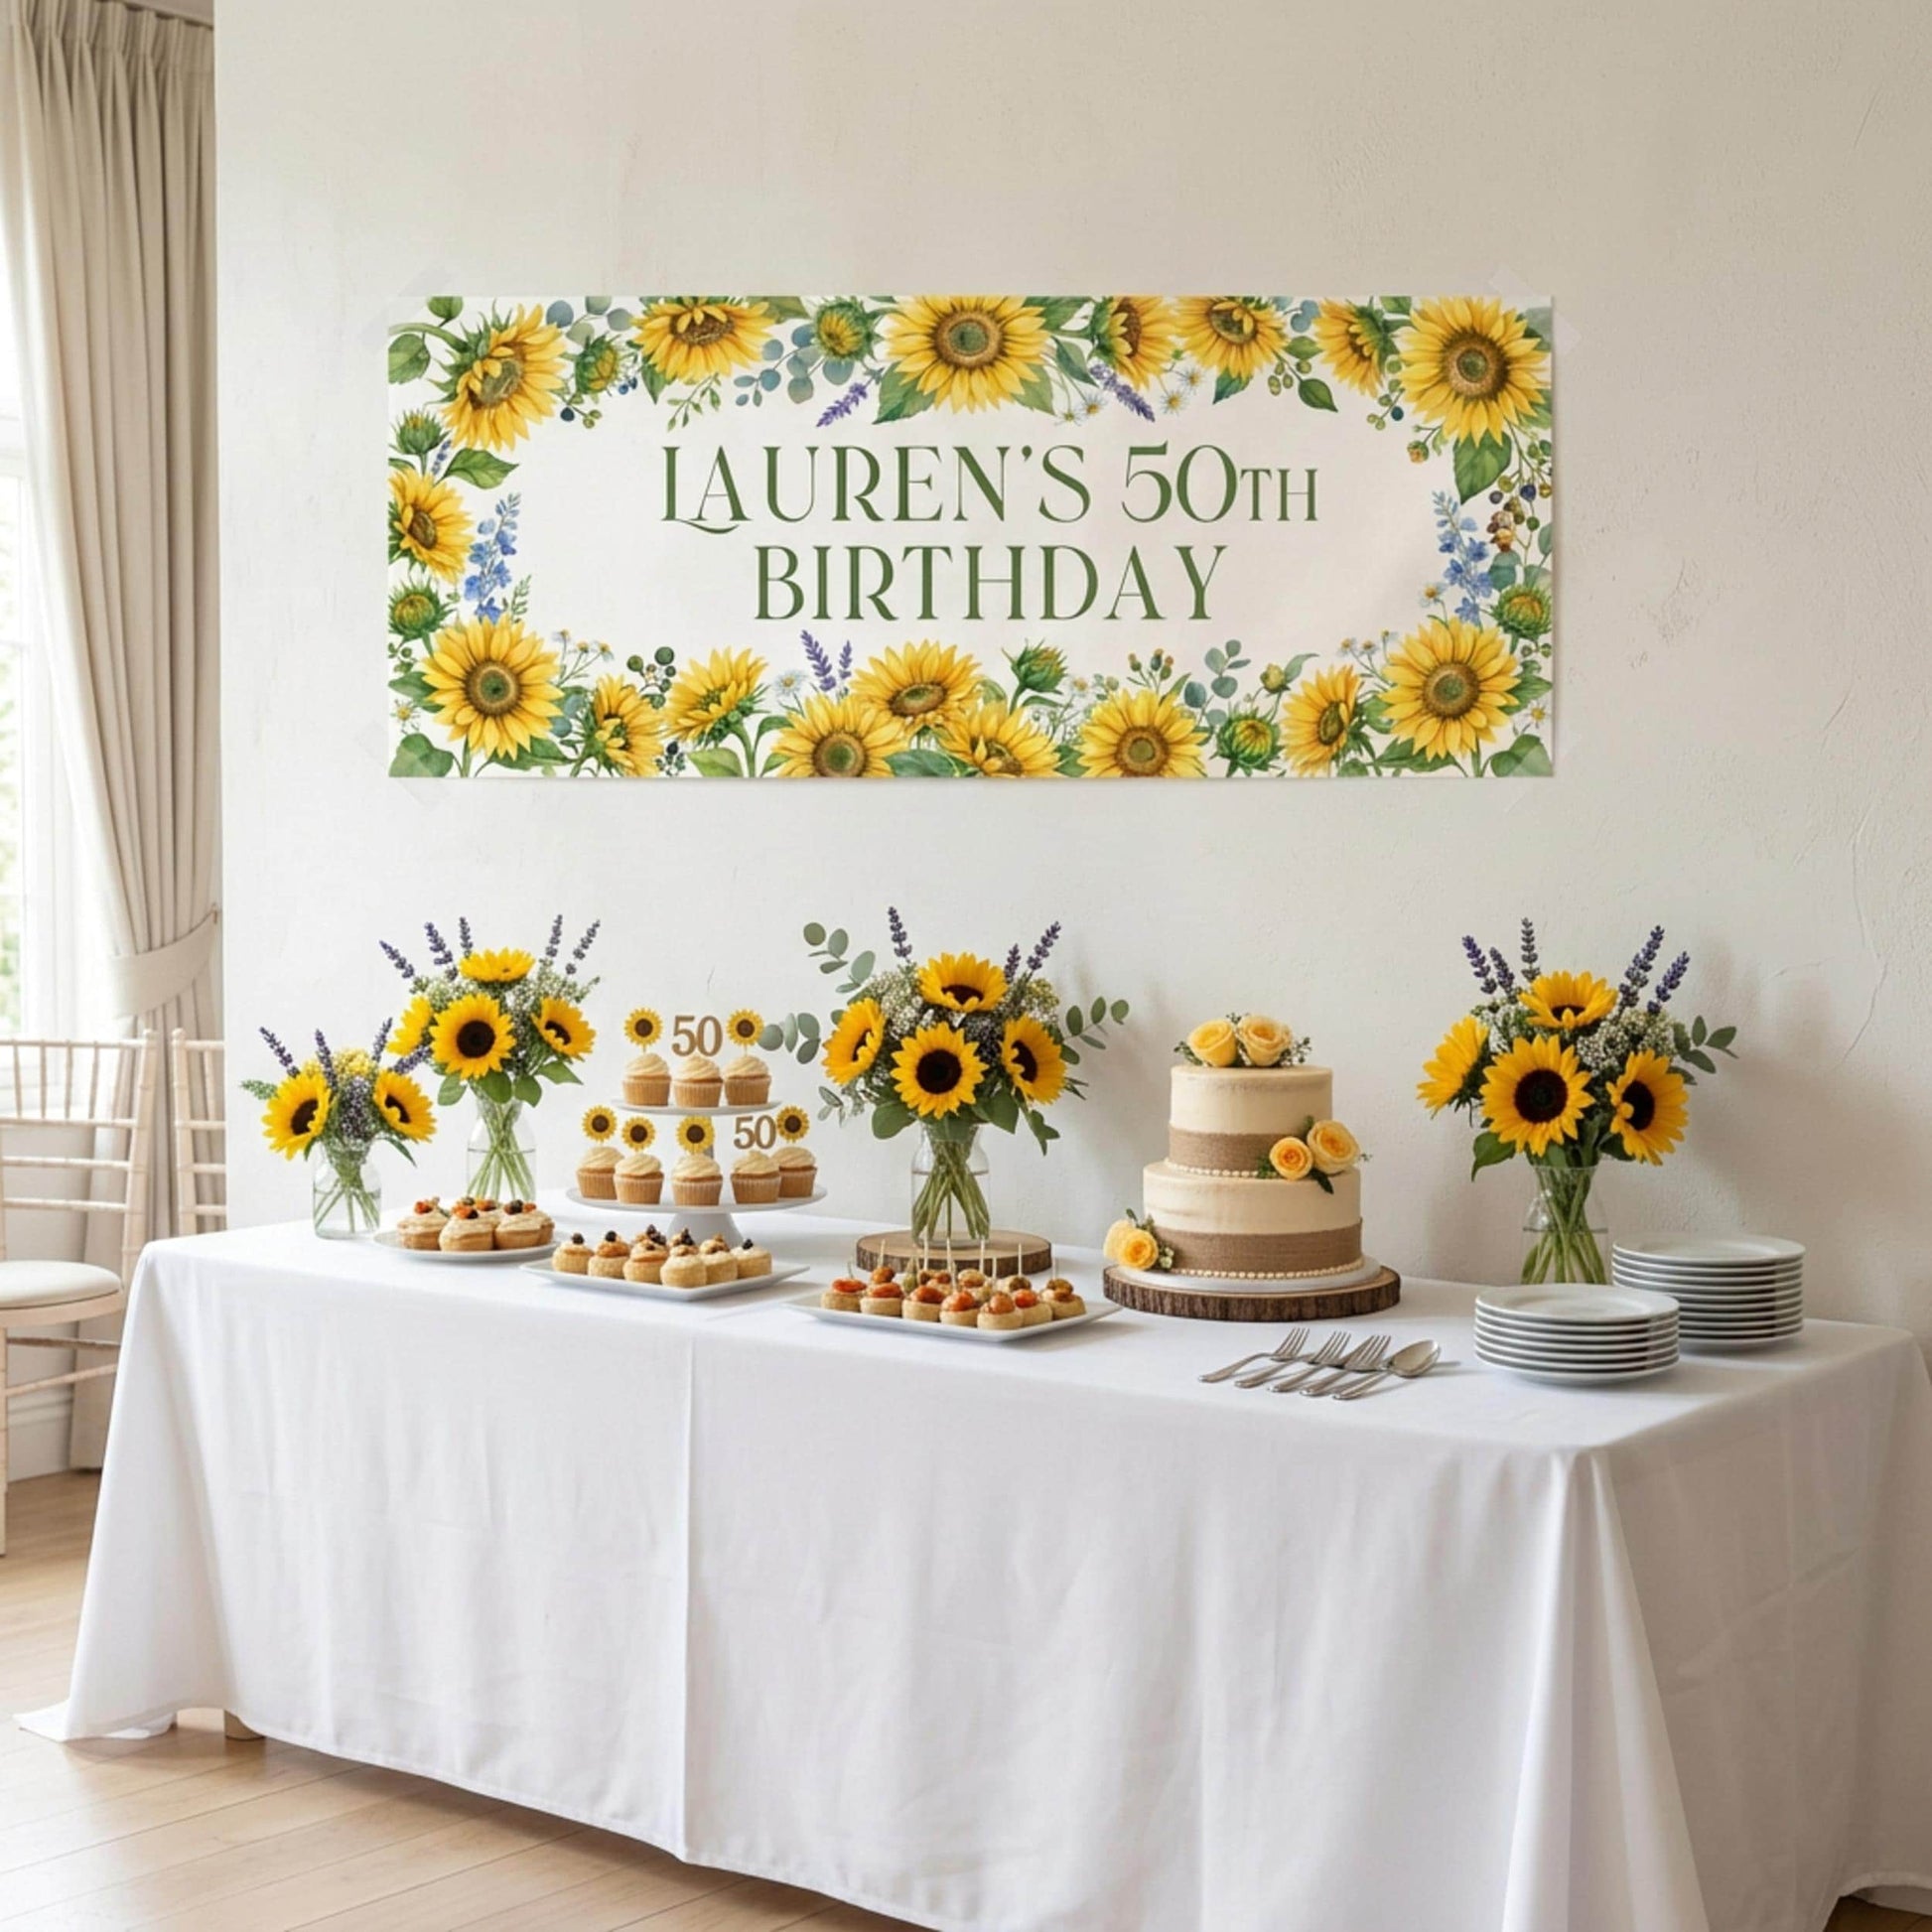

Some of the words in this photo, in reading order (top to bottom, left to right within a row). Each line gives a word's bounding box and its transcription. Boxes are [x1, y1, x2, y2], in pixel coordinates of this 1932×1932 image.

[660, 444, 1092, 534] LAUREN'S
[1121, 440, 1319, 523] 50TH
[754, 544, 1228, 621] BIRTHDAY
[671, 1015, 724, 1057] 50
[733, 1115, 777, 1151] 50
